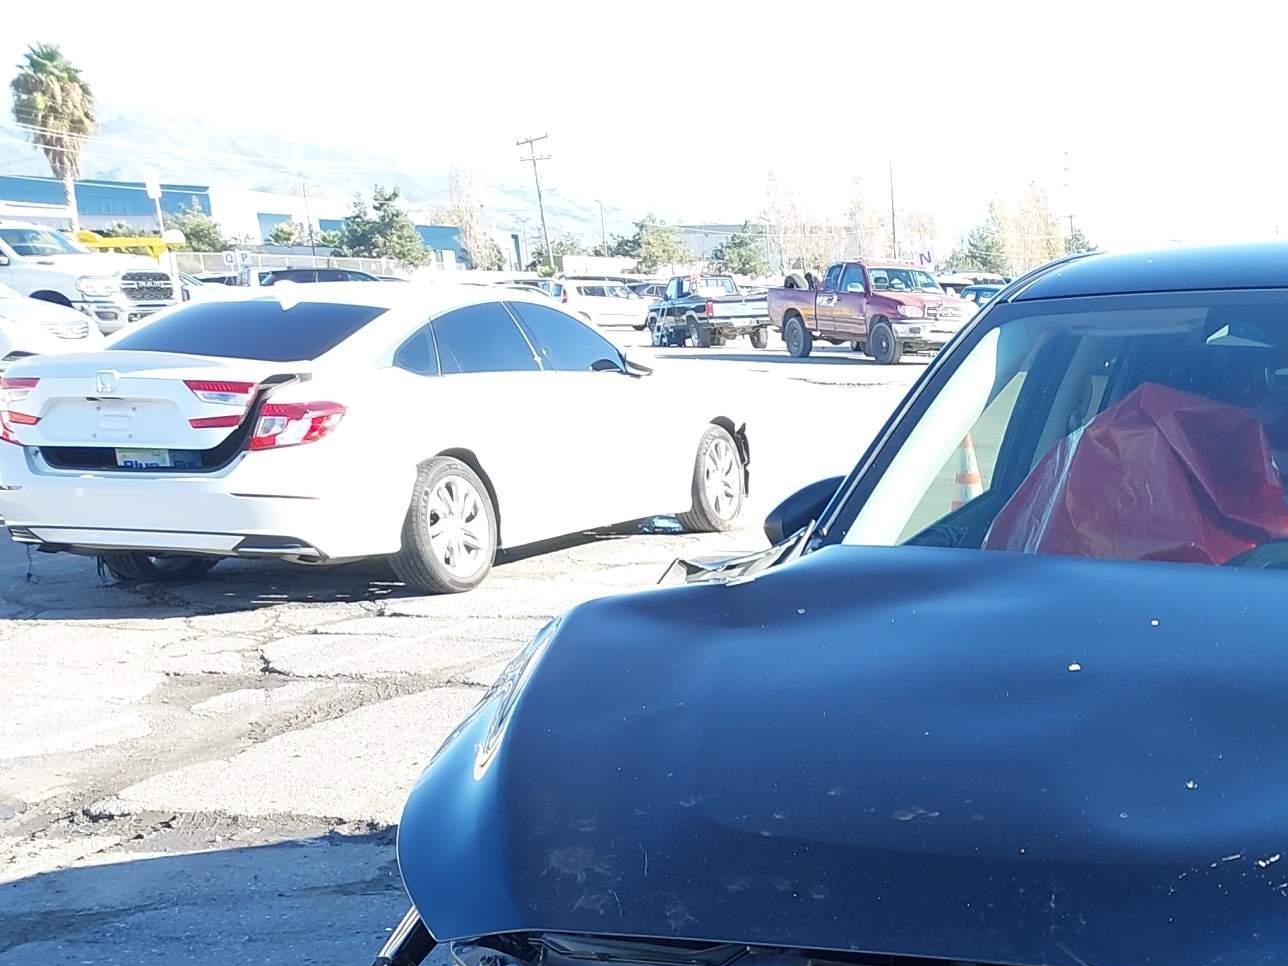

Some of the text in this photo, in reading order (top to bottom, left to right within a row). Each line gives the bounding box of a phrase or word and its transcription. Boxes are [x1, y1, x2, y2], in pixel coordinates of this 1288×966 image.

[225, 253, 234, 263] Q
[241, 253, 248, 262] P
[919, 250, 932, 265] N
